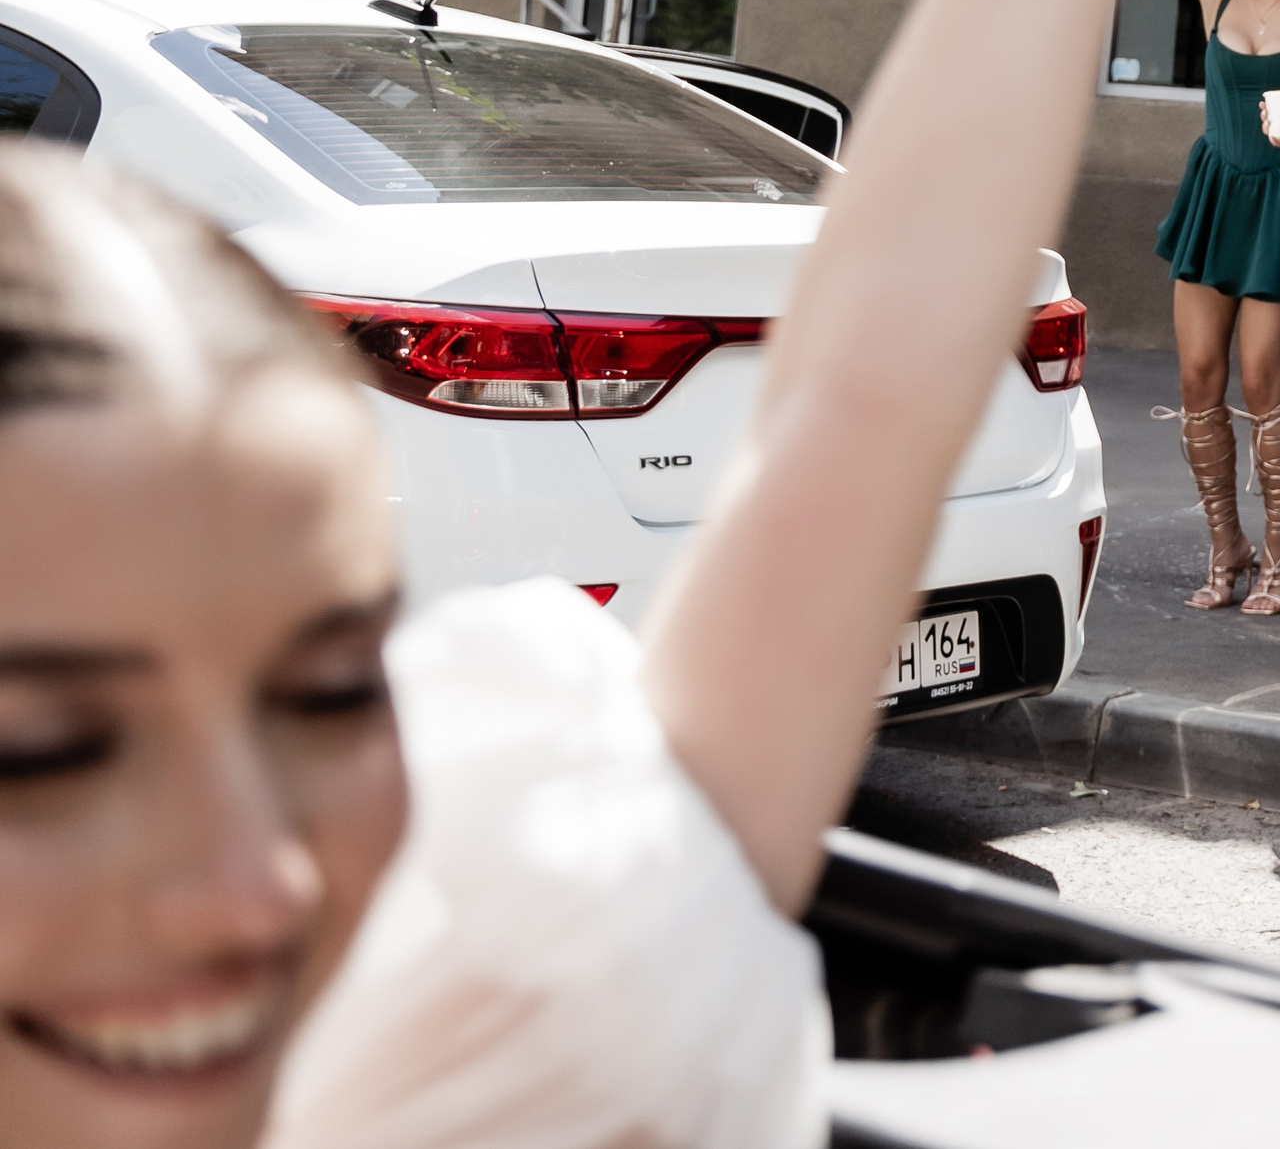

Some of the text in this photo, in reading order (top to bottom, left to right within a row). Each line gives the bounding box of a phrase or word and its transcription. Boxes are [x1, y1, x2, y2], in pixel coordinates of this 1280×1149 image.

[639, 455, 692, 470] RIO
[924, 617, 971, 661] 164
[935, 660, 958, 678] RUS
